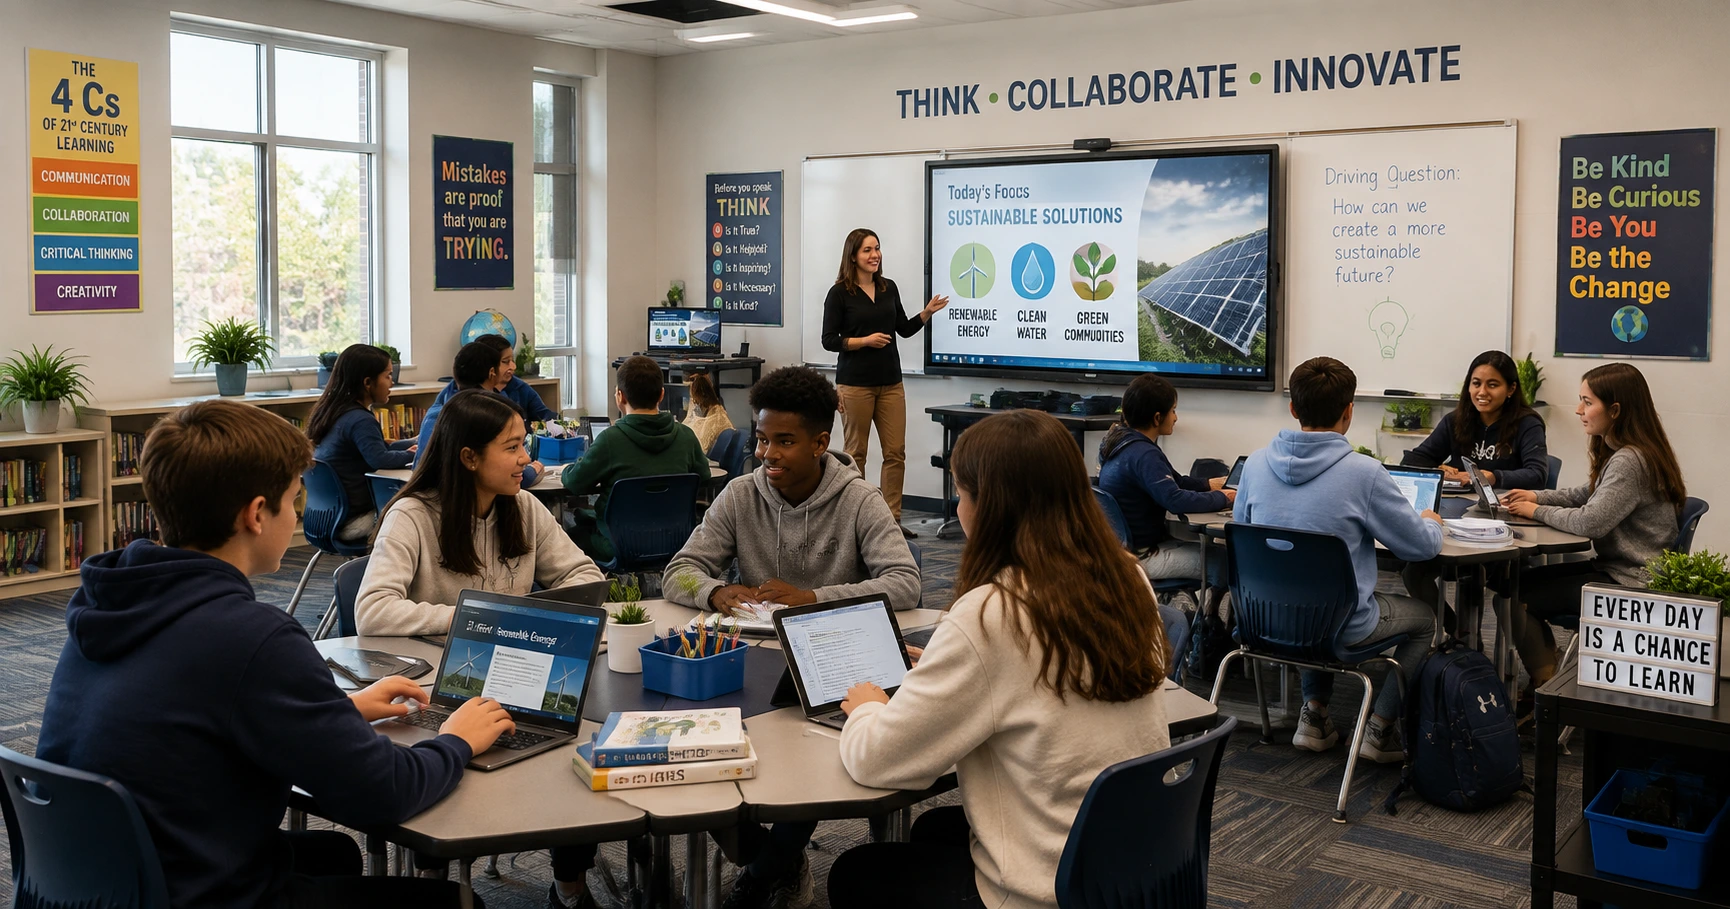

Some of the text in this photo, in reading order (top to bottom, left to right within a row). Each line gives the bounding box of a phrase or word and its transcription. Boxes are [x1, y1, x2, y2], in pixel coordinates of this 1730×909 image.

[71, 60, 96, 77] THE
[896, 45, 1462, 119] THINK COLLABORATE INNOVATE
[51, 78, 120, 119] 4 Cs
[43, 117, 57, 131] OF
[80, 120, 128, 137] CENTURY
[57, 135, 115, 154] LEARNING
[442, 160, 507, 185] Mistakes
[1572, 153, 1670, 179] Be Kind
[41, 169, 131, 187] COMMUNICATION
[1325, 164, 1460, 192] Driving Question:
[444, 189, 503, 210] are proof
[948, 184, 991, 204] Today's
[1571, 183, 1701, 209] Be Curious
[42, 208, 130, 224] COLLABORATION
[716, 197, 771, 217] THINK
[948, 206, 1123, 226] SUSTAINABLE SOLUTIONS
[1333, 198, 1428, 215] How can we
[442, 211, 507, 232] that you are
[1332, 221, 1446, 238] create a more
[1571, 214, 1657, 238] Be You
[40, 246, 133, 261] CRITICAL THINKING
[1334, 242, 1421, 260] sustainable
[1570, 245, 1652, 269] Be the
[1335, 265, 1395, 287] future?
[57, 285, 118, 298] CREATIVITY
[1569, 274, 1671, 305] Change
[949, 308, 998, 321] RENEWABLE
[1017, 310, 1047, 323] CLEAN
[1077, 311, 1109, 325] GREEN
[1016, 326, 1047, 340] WATER
[1593, 595, 1704, 631] EVERY DAY
[1585, 626, 1711, 666] IS A CHANCE
[1593, 659, 1695, 696] TO LEARN
